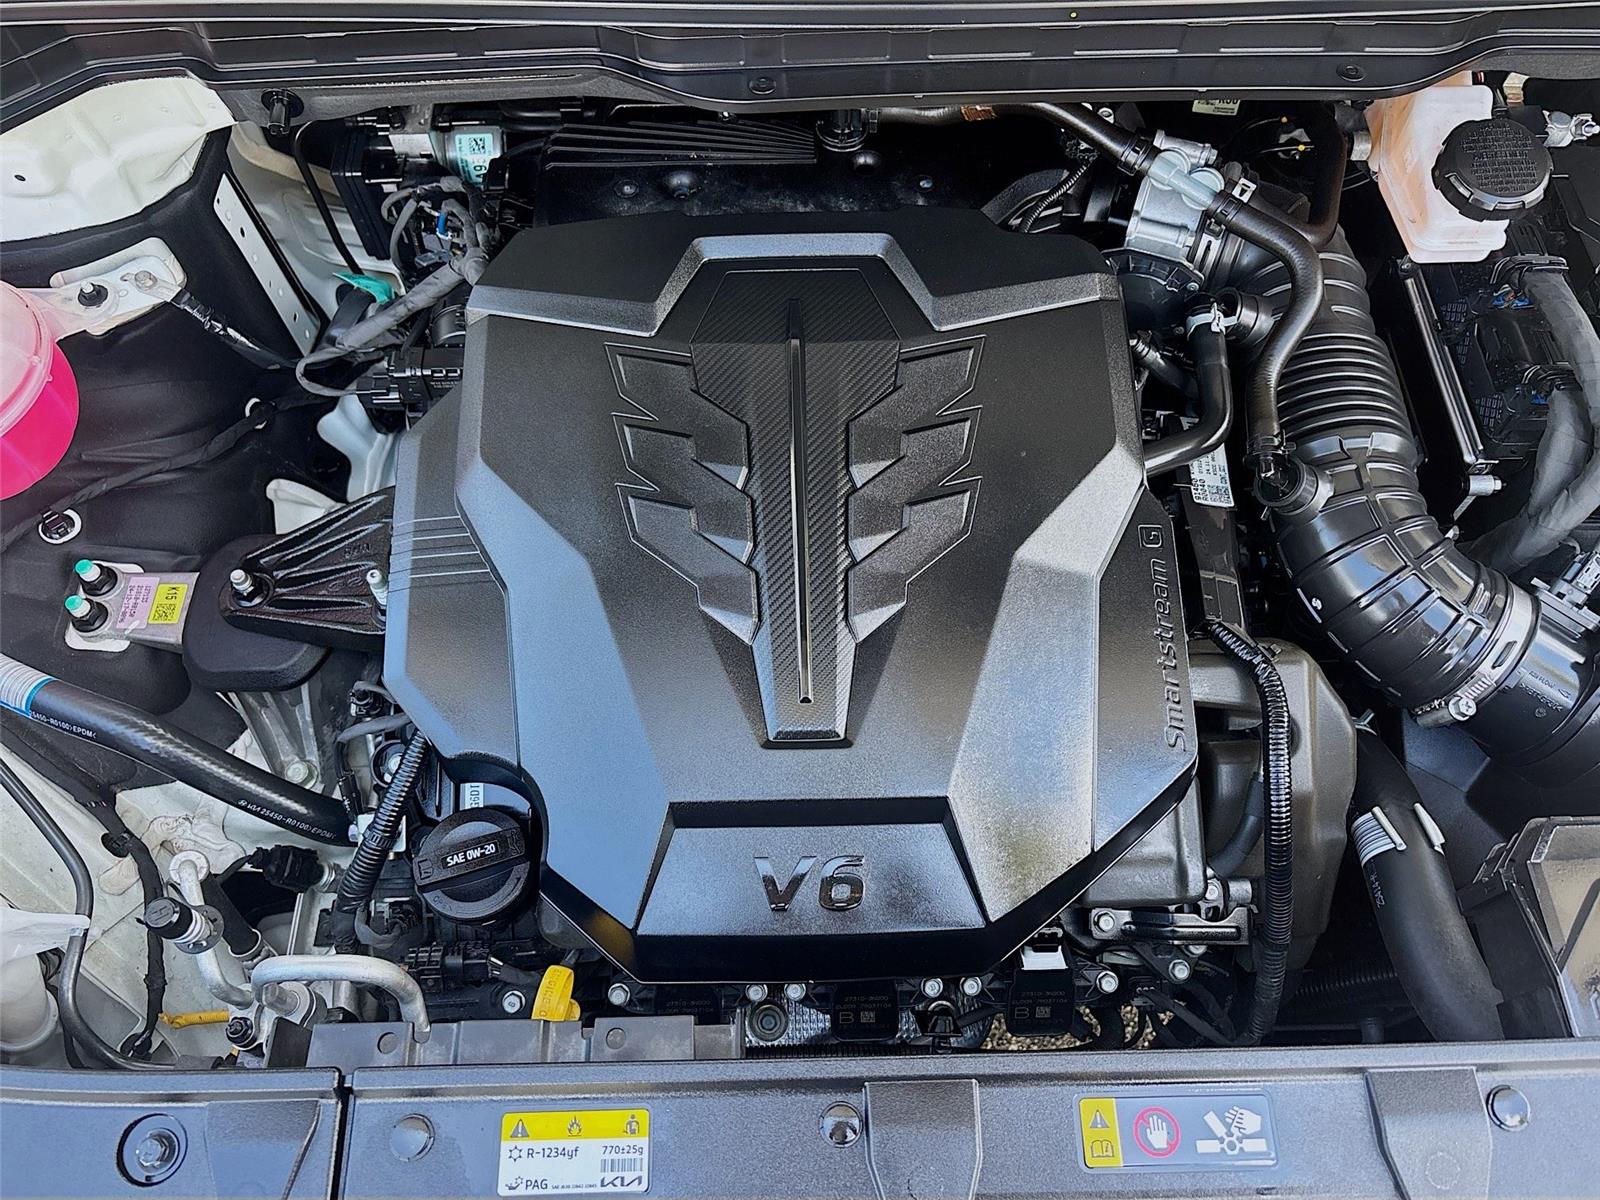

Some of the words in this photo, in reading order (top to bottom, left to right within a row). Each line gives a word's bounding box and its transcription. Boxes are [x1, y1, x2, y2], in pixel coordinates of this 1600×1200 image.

[165, 586, 180, 601] K15
[1150, 557, 1187, 753] Smartstream
[446, 853, 467, 868] SAE
[466, 843, 496, 861] 0W-20
[753, 855, 866, 912] V6
[839, 1011, 855, 1024] B
[1014, 1006, 1030, 1019] B
[526, 1146, 580, 1160] R-1234yf
[602, 1144, 644, 1156] 770±25g
[525, 1178, 549, 1190] PAG
[600, 1175, 643, 1189] KIA
